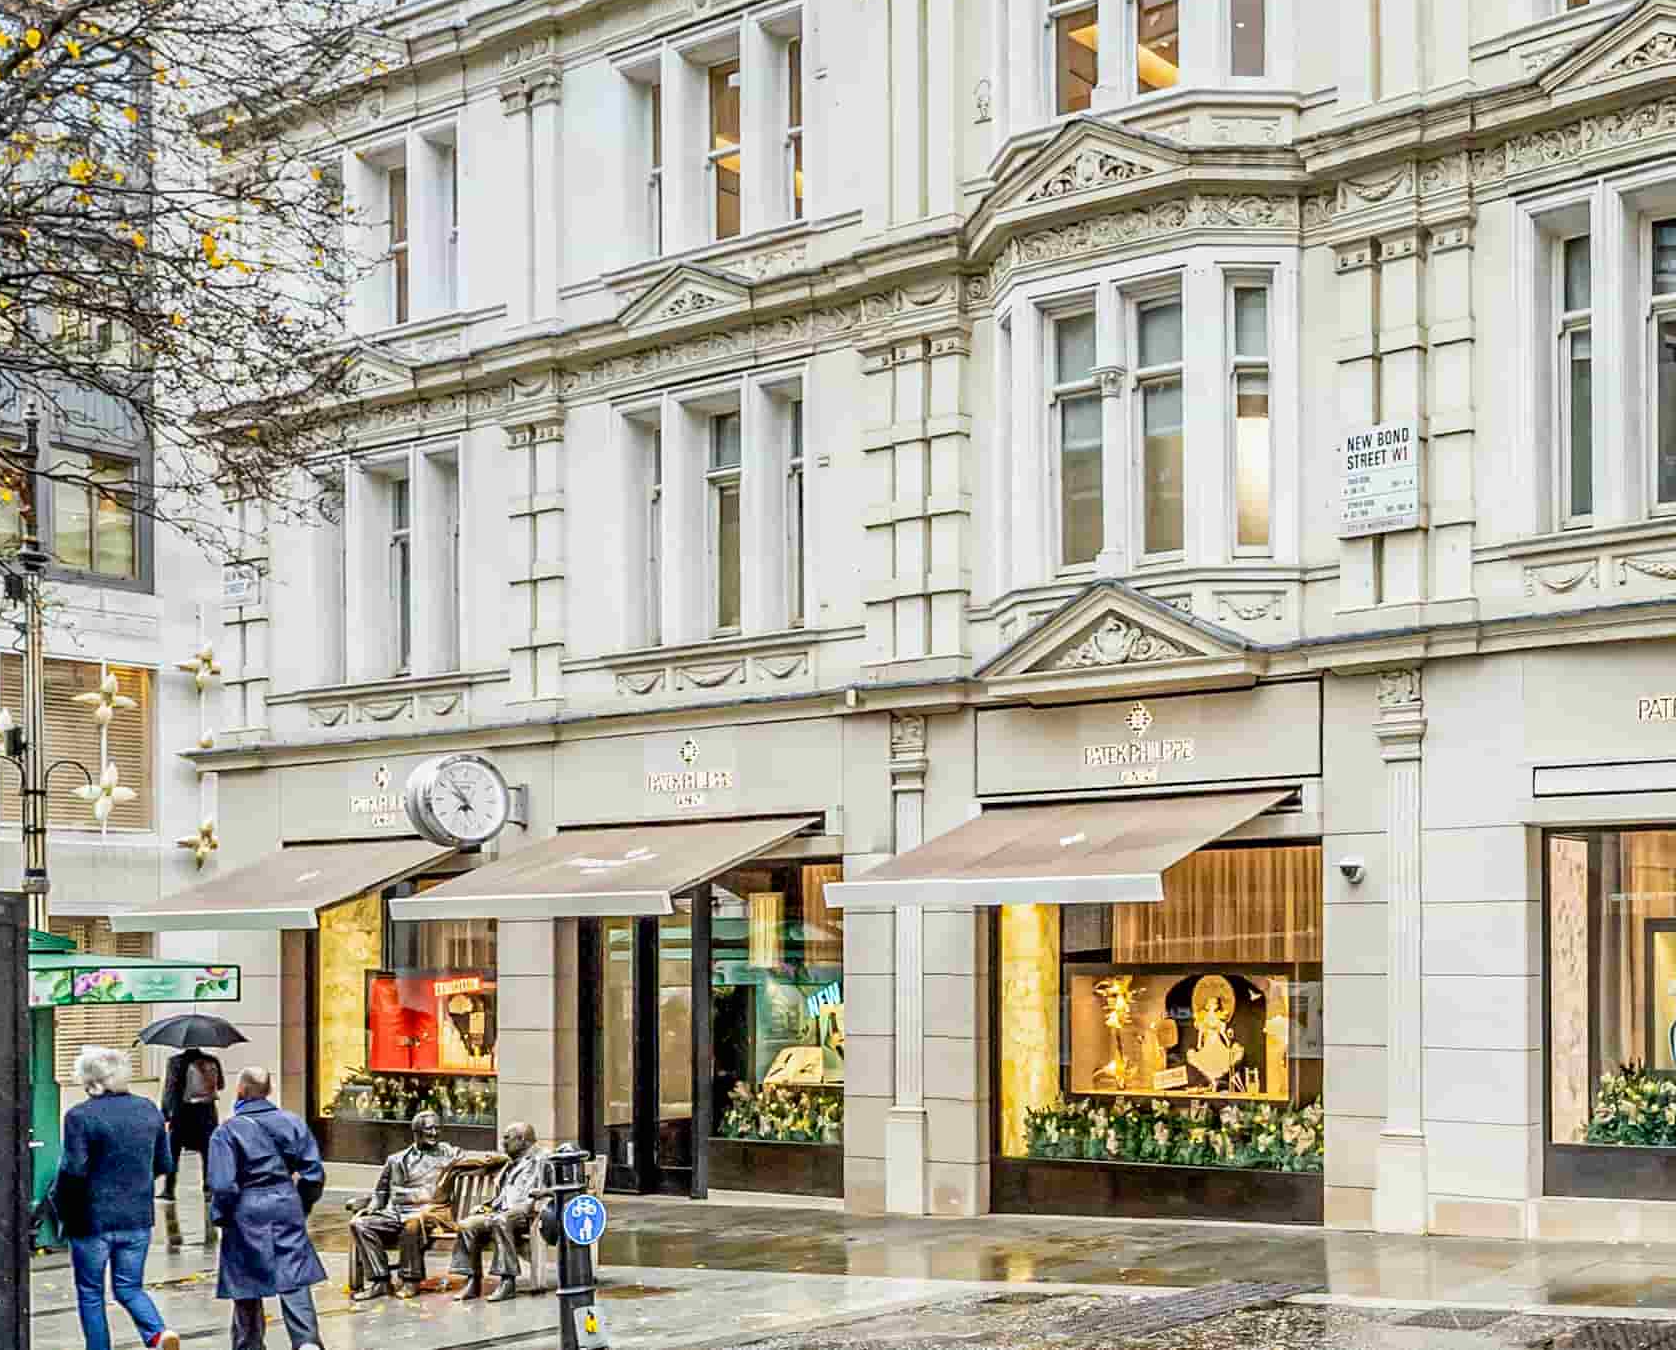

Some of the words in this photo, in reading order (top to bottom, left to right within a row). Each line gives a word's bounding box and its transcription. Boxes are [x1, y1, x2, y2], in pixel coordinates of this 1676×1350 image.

[1347, 434, 1372, 452] NEW
[1377, 427, 1410, 447] BOND
[1347, 450, 1387, 470] STREET
[1392, 445, 1408, 462] W1
